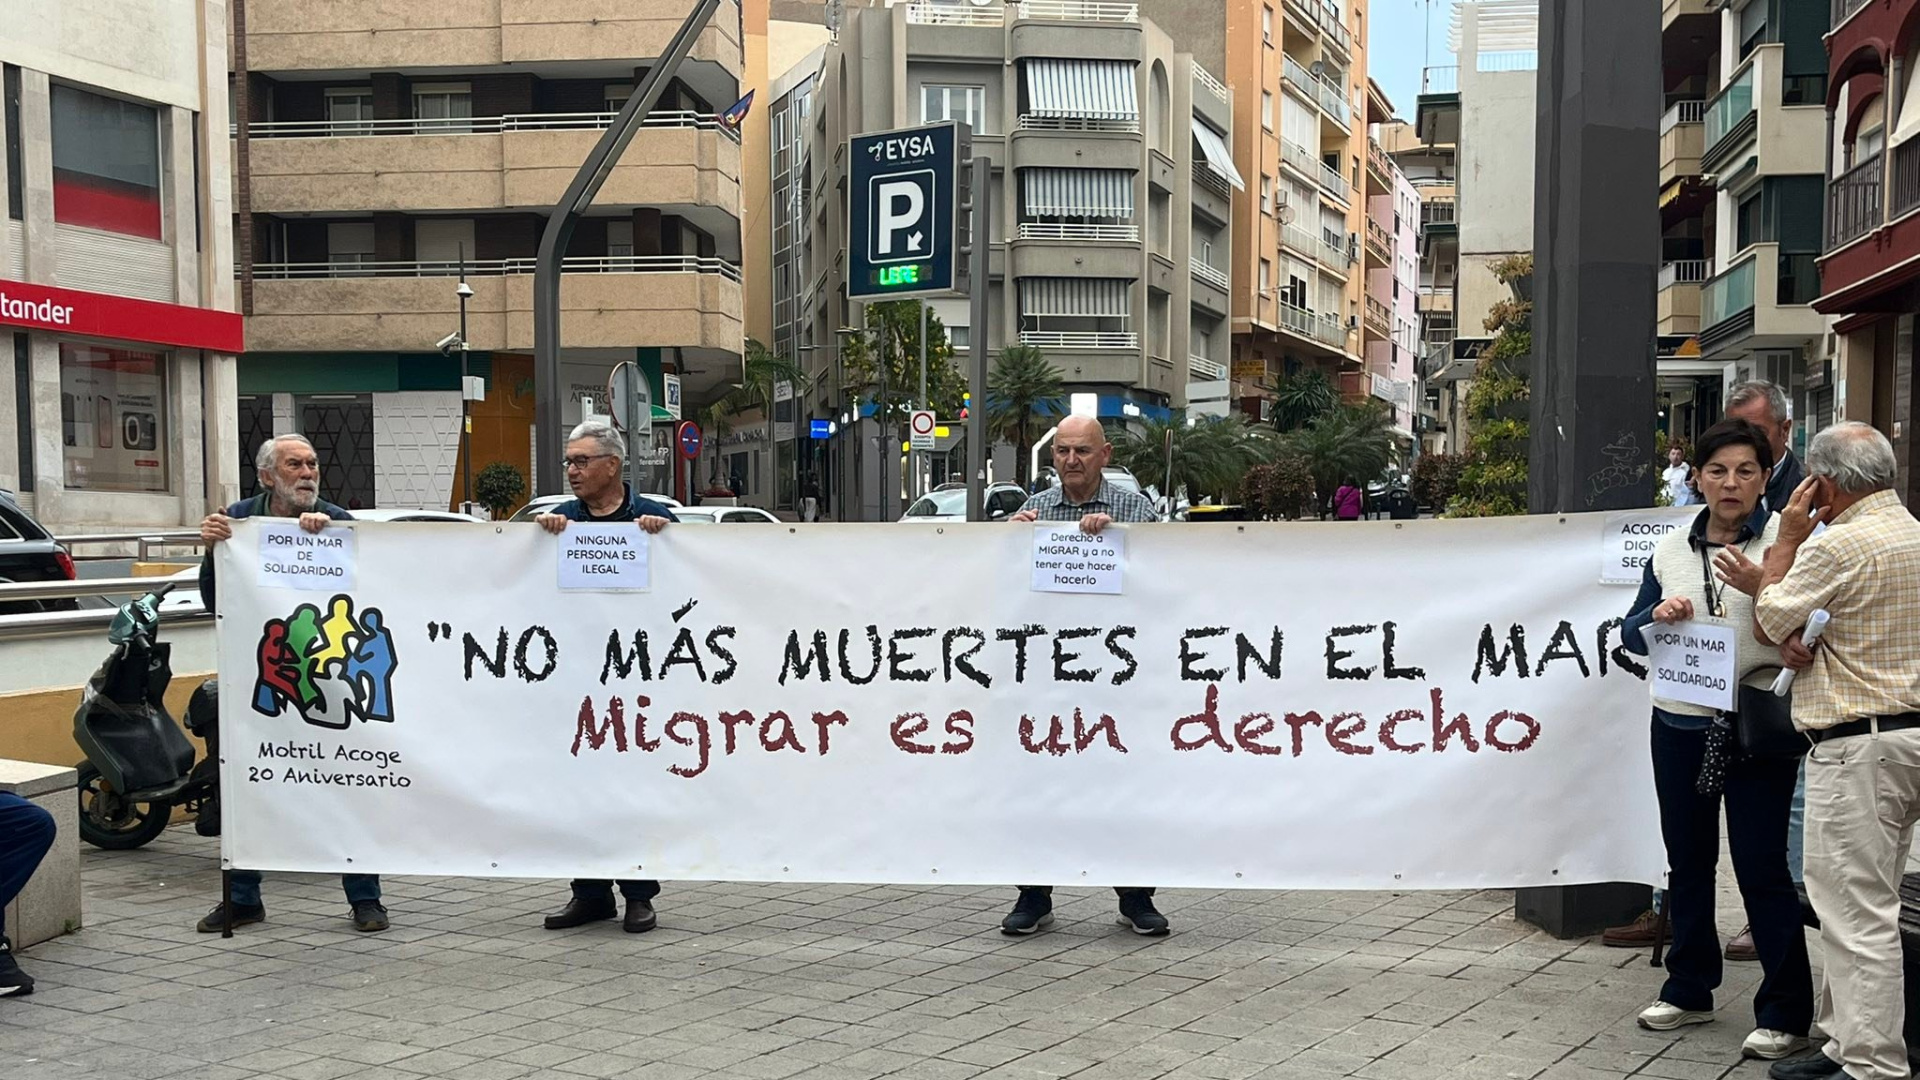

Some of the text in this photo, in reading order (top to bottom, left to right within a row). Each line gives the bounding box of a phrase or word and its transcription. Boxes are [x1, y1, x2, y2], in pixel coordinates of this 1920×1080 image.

[886, 134, 935, 160] EYSA
[878, 181, 924, 254] P
[880, 264, 919, 285] LIBRE
[0, 292, 74, 325] tander
[1621, 523, 1682, 536] ACOGID
[267, 534, 343, 549] POR UN MAR
[575, 535, 628, 546] NINGUNA
[1051, 532, 1104, 544] Derecho a
[1038, 545, 1115, 558] MIGRAR y a no
[1624, 540, 1660, 552] DIGN
[297, 550, 313, 562] DE
[566, 549, 637, 561] PERSONA ES
[264, 562, 344, 577] SOLIDARIDAD
[582, 564, 620, 575] ILEGAL
[1035, 560, 1117, 571] tener que hacer
[1621, 556, 1648, 569] SEG
[1054, 574, 1097, 585] hacerlo
[600, 598, 738, 686] MÁS
[778, 624, 1137, 689] MUERTES
[1179, 624, 1285, 683] EN
[1326, 620, 1427, 682] EL
[1472, 616, 1650, 684] MAR
[1655, 634, 1725, 653] POR UN MAR
[1685, 654, 1700, 668] DE
[1658, 668, 1727, 691] SOLIDARIDAD
[570, 683, 1541, 778] Migrar es un derecho
[258, 741, 402, 769] Motril Acoge
[249, 766, 411, 788] 20 Aniversario
